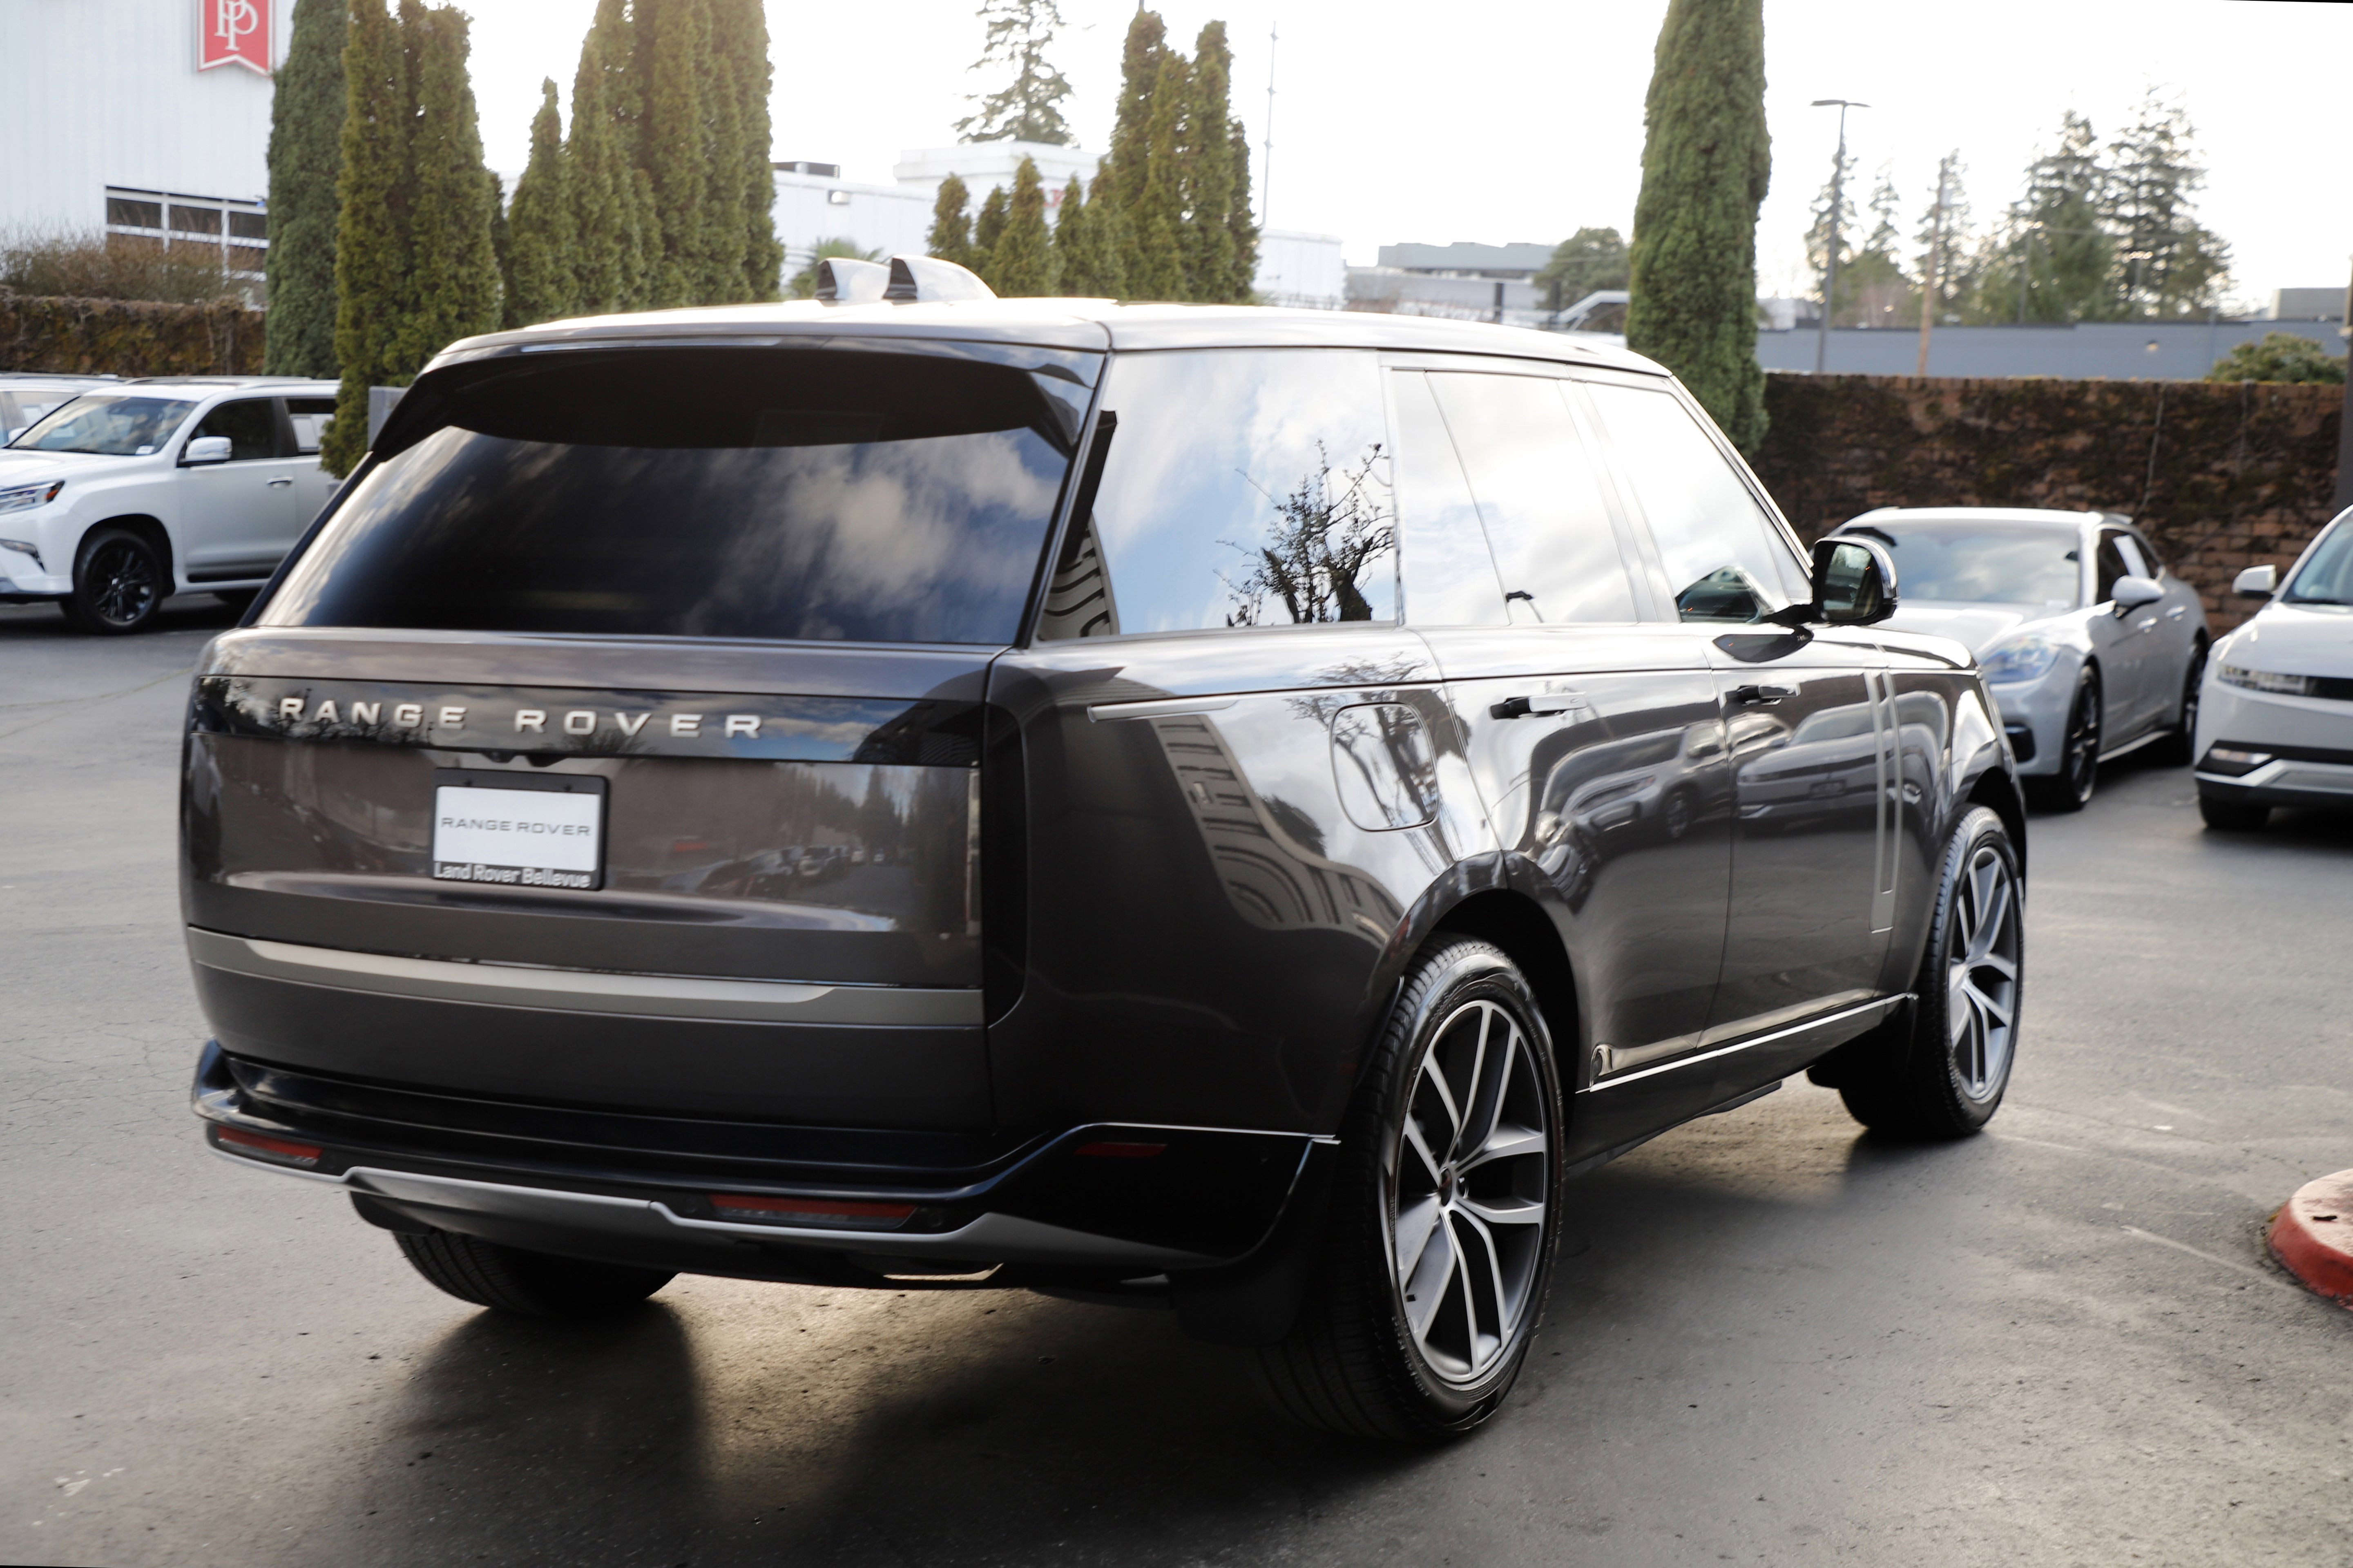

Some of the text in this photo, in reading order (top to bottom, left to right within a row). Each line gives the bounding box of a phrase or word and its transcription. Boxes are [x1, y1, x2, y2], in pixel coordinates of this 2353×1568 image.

[279, 698, 761, 739] RANGE ROVER
[441, 818, 590, 836] RANGE ROVER
[434, 862, 591, 888] Land Rover Bellevue
